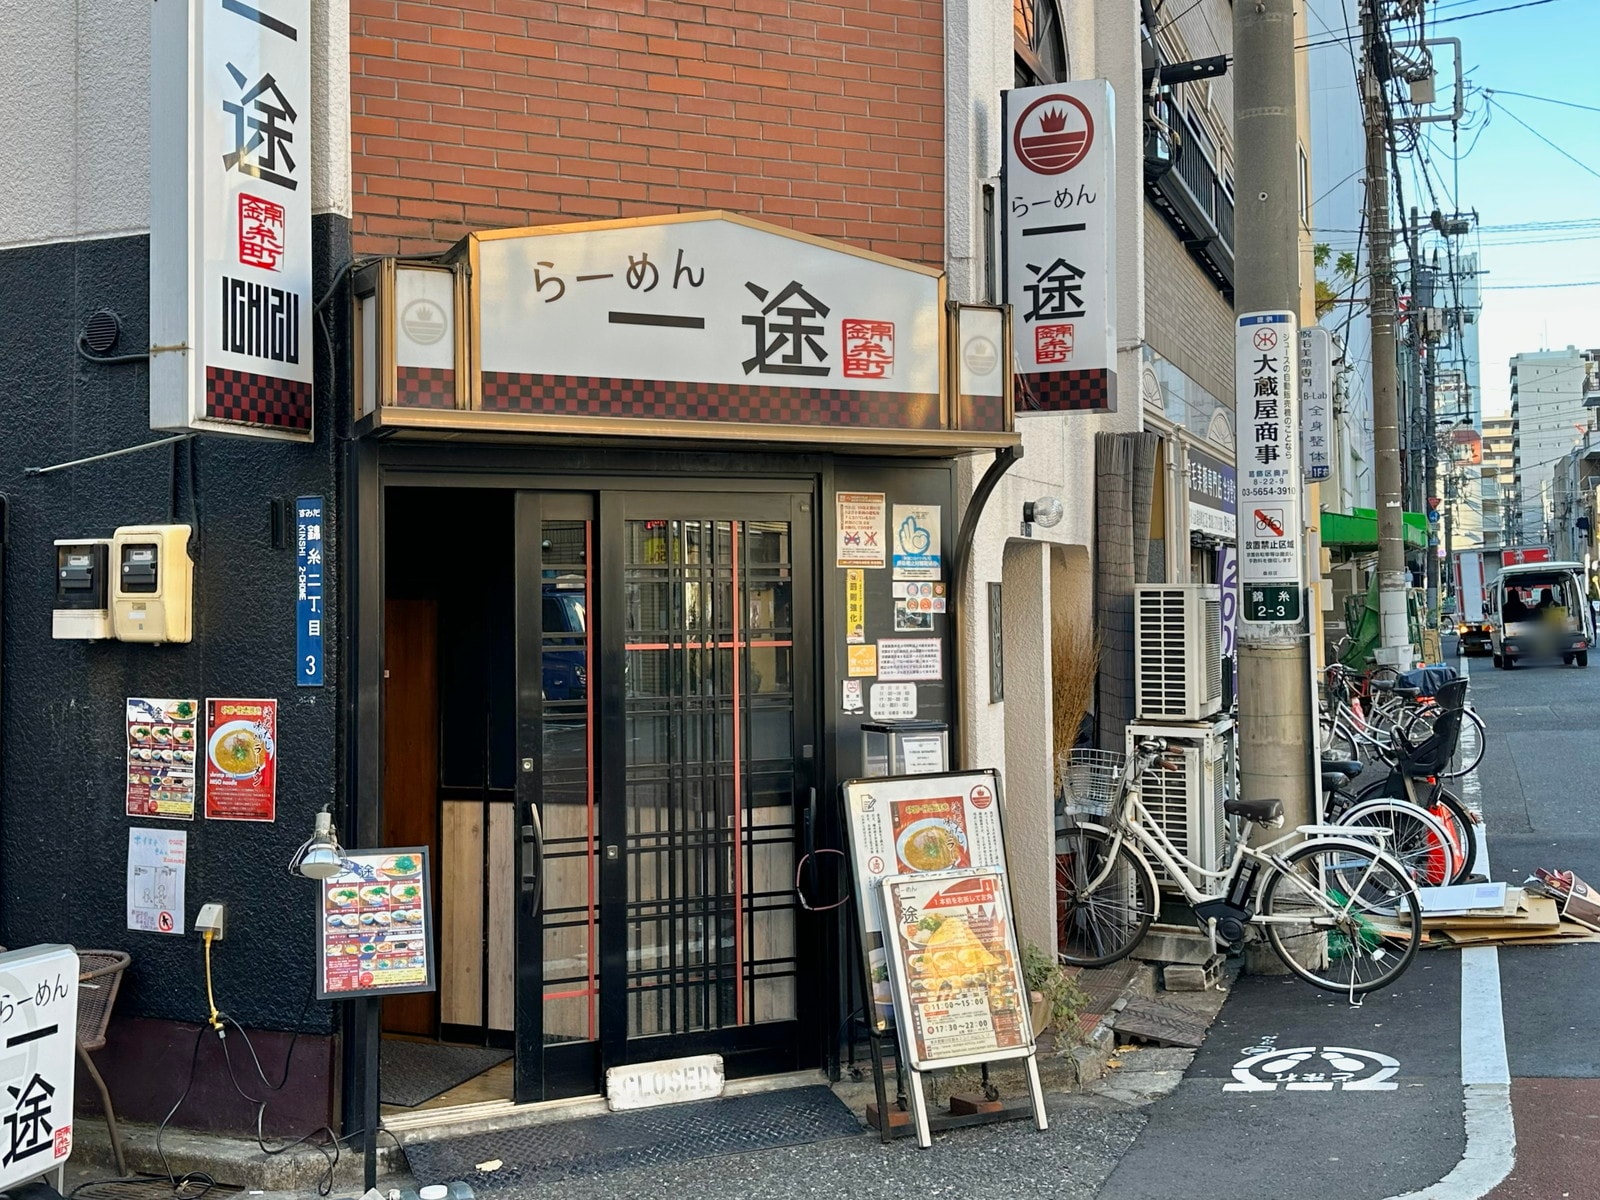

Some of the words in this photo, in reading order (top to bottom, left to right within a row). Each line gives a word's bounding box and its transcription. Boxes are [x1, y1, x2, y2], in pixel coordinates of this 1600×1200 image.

[1012, 184, 1096, 218] らーめん
[534, 249, 705, 303] らーめん
[1022, 223, 1086, 324] 一途
[222, 276, 299, 365] ICHIZU
[608, 280, 831, 377] 一途
[842, 319, 895, 379] 錦糸町
[1253, 354, 1281, 465] 大蔵屋商事
[1303, 392, 1328, 400] B-Lab
[1309, 405, 1325, 462] 全身整体
[1242, 487, 1296, 496] 03-5654-3910
[1253, 478, 1285, 486] 8-22-9
[298, 524, 307, 557] KINSHI
[1246, 540, 1295, 550] 放置禁止区域
[298, 565, 307, 601] 2-CHOME
[307, 524, 321, 637] 錦糸二丁目
[1252, 590, 1291, 602] 錦糸
[1257, 605, 1286, 617] 2-3
[305, 655, 317, 676] 3
[0, 973, 69, 1024] らーめん
[2, 1024, 59, 1169] 一途
